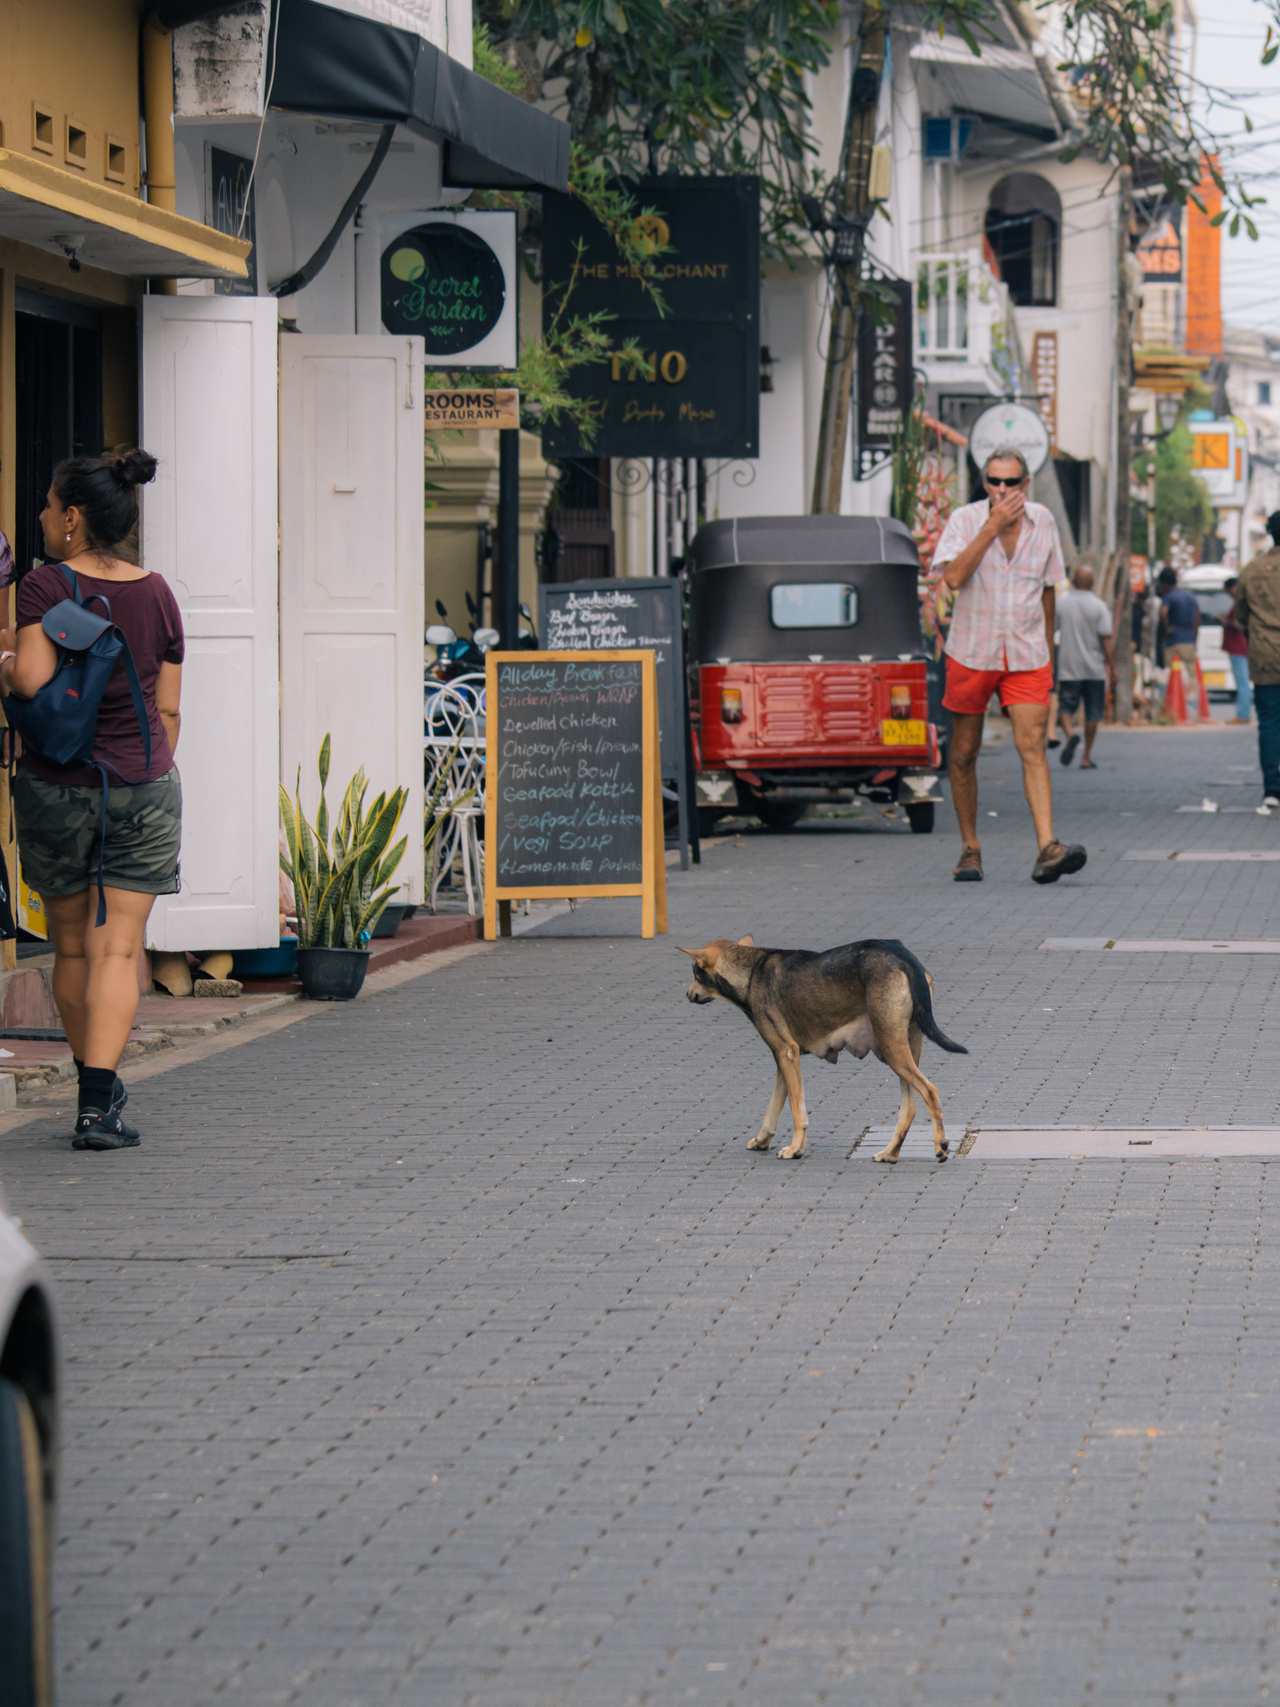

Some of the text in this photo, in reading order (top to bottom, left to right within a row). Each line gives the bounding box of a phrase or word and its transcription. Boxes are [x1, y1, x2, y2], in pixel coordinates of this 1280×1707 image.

[408, 264, 482, 298] Secret
[570, 264, 609, 279] THE
[402, 292, 487, 322] Garden
[425, 393, 495, 409] ROOMS
[426, 409, 501, 420] ESTAURANT
[597, 686, 638, 705] WRAP
[577, 759, 620, 780] Bowl
[559, 831, 613, 852] Soup
